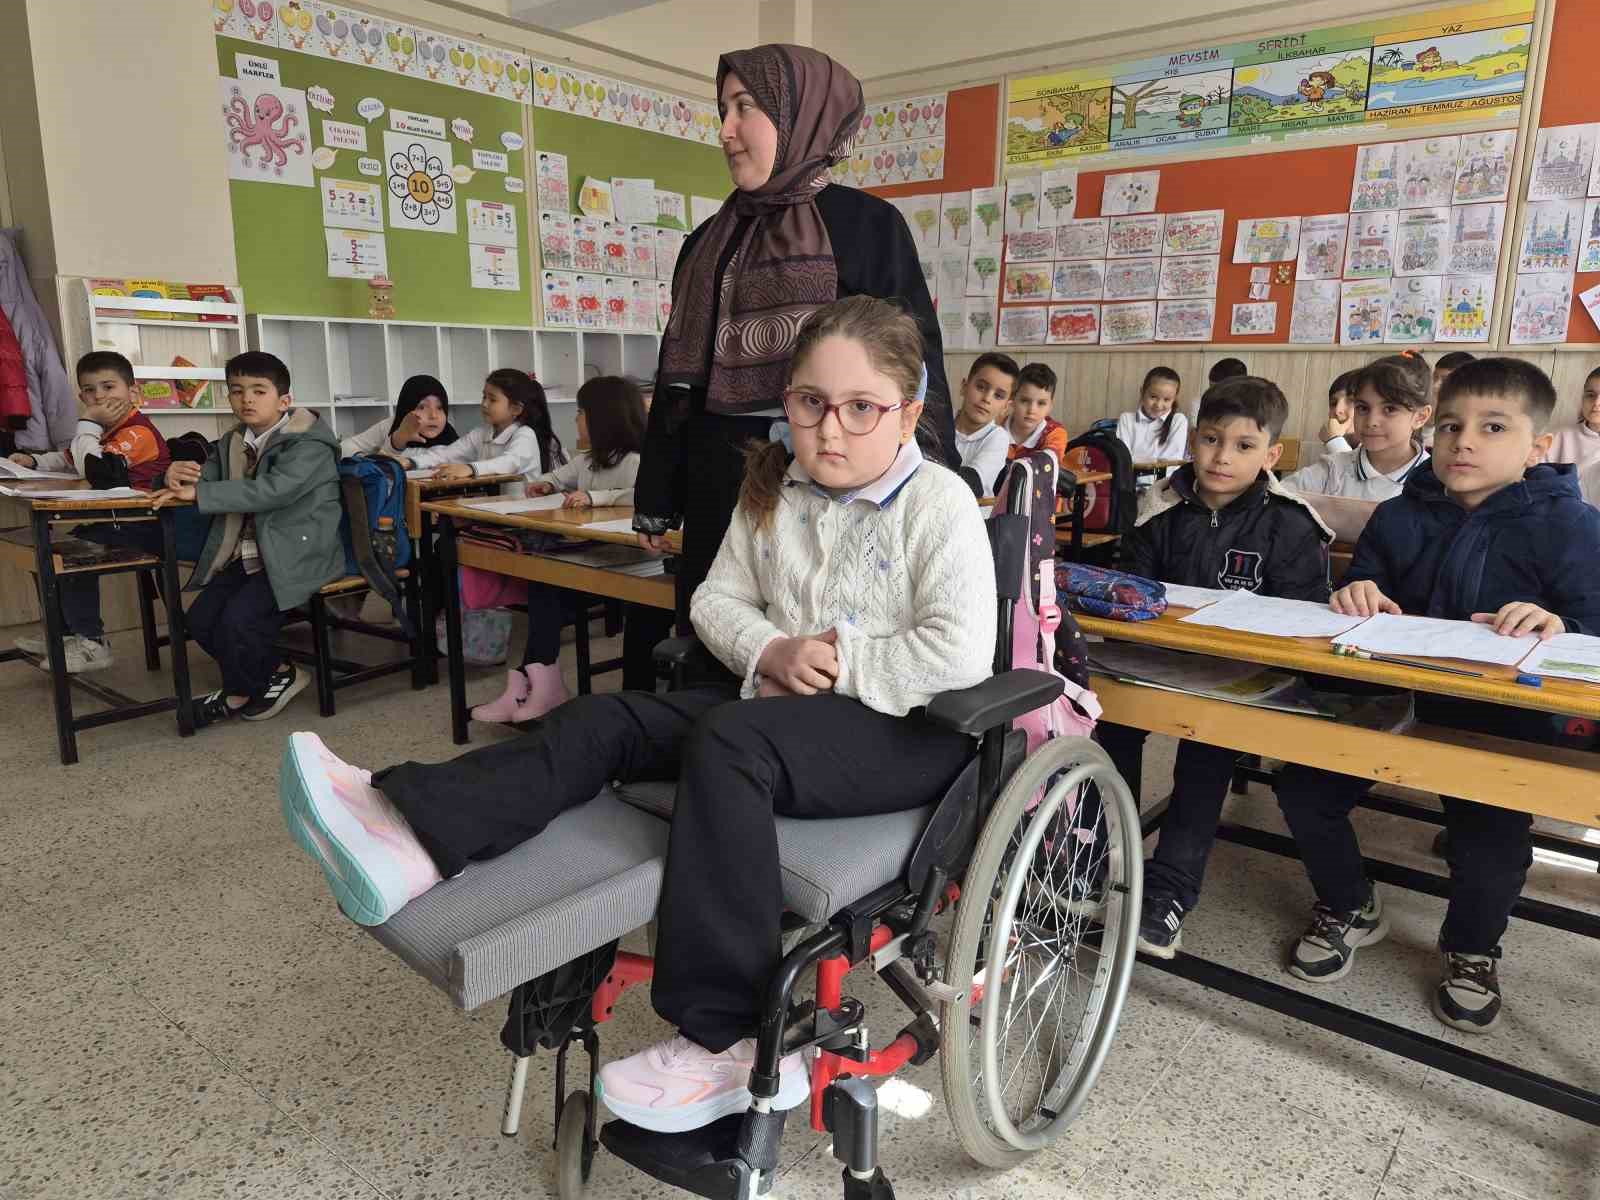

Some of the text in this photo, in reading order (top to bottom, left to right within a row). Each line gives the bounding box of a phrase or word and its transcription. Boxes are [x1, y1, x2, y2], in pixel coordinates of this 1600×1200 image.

[1441, 24, 1463, 33] YAZ
[1168, 48, 1220, 66] MEVSİM
[1278, 46, 1326, 60] İLKBAHAR
[248, 60, 268, 71] ÜNLÜ
[242, 68, 276, 79] HARFLER
[1036, 83, 1080, 97] SONBAHAR
[1369, 107, 1411, 119] HAZİRAN
[1422, 101, 1464, 112] TEMMUZ
[396, 121, 406, 129] 10
[1238, 115, 1354, 133] MART NİSAN MAYIS
[412, 179, 429, 194] 10
[329, 190, 336, 201] 5
[348, 192, 354, 203] 2
[423, 208, 436, 217] 3+7
[505, 212, 511, 223] 5
[351, 239, 357, 250] 5
[351, 250, 358, 262] 2
